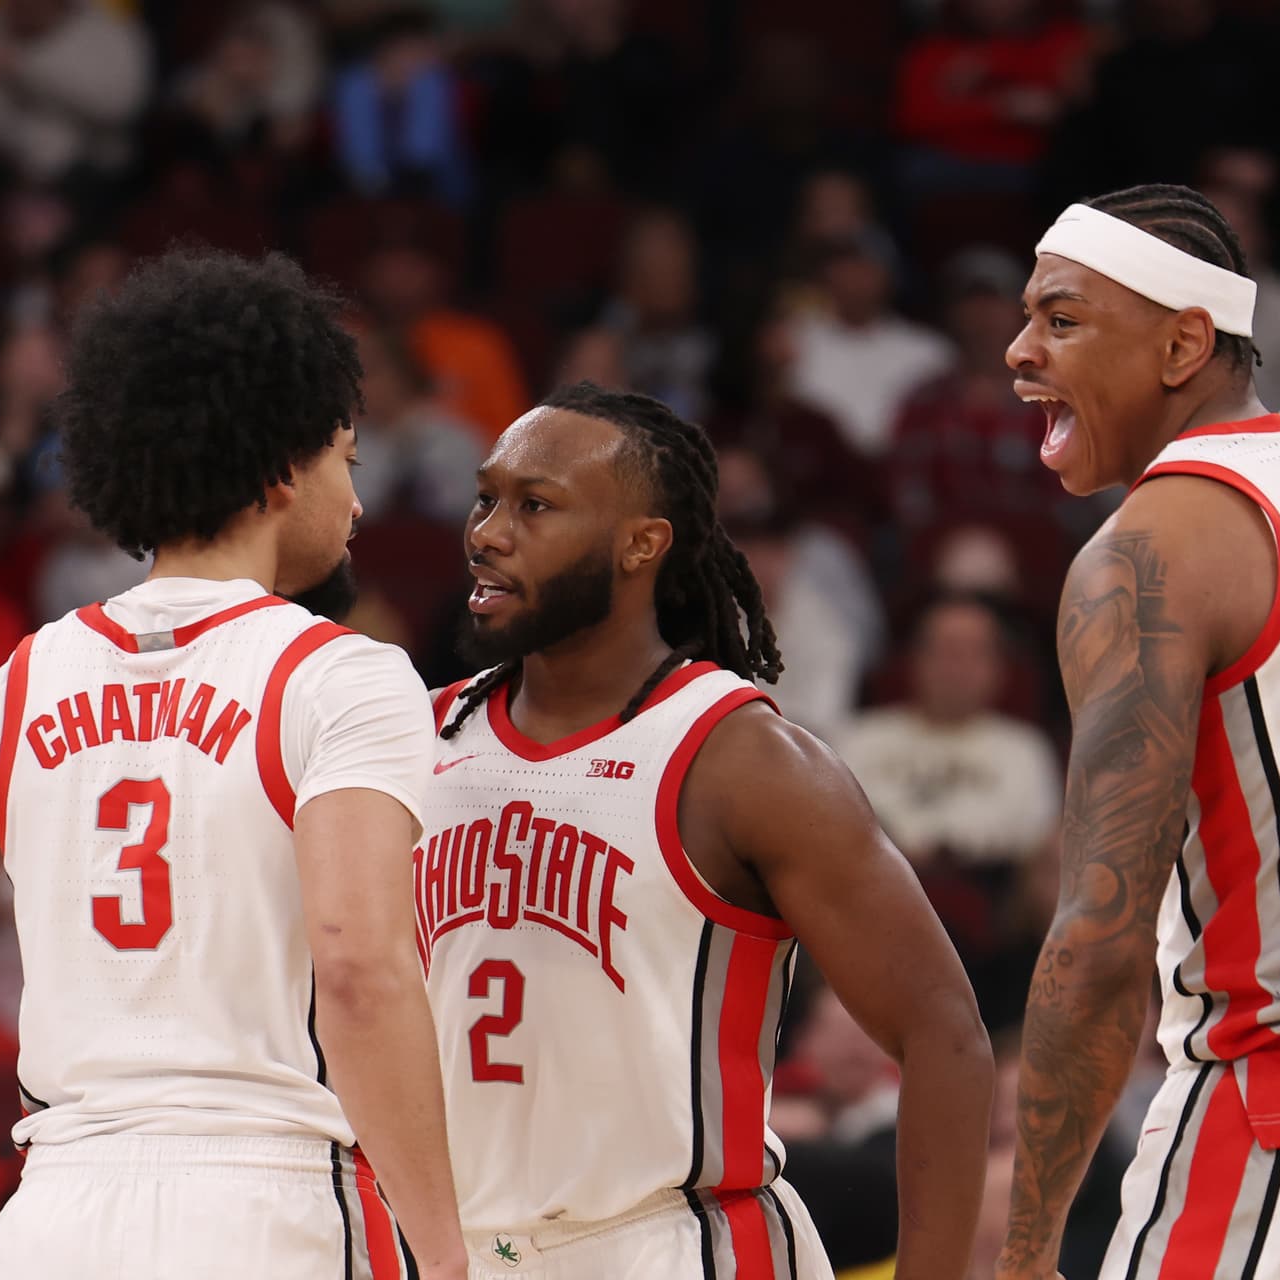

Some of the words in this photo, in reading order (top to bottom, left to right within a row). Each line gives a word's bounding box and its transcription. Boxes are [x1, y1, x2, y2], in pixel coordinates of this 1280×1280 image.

[25, 677, 252, 770] CHATMAN
[91, 775, 175, 952] 3
[467, 959, 526, 1085] 2
